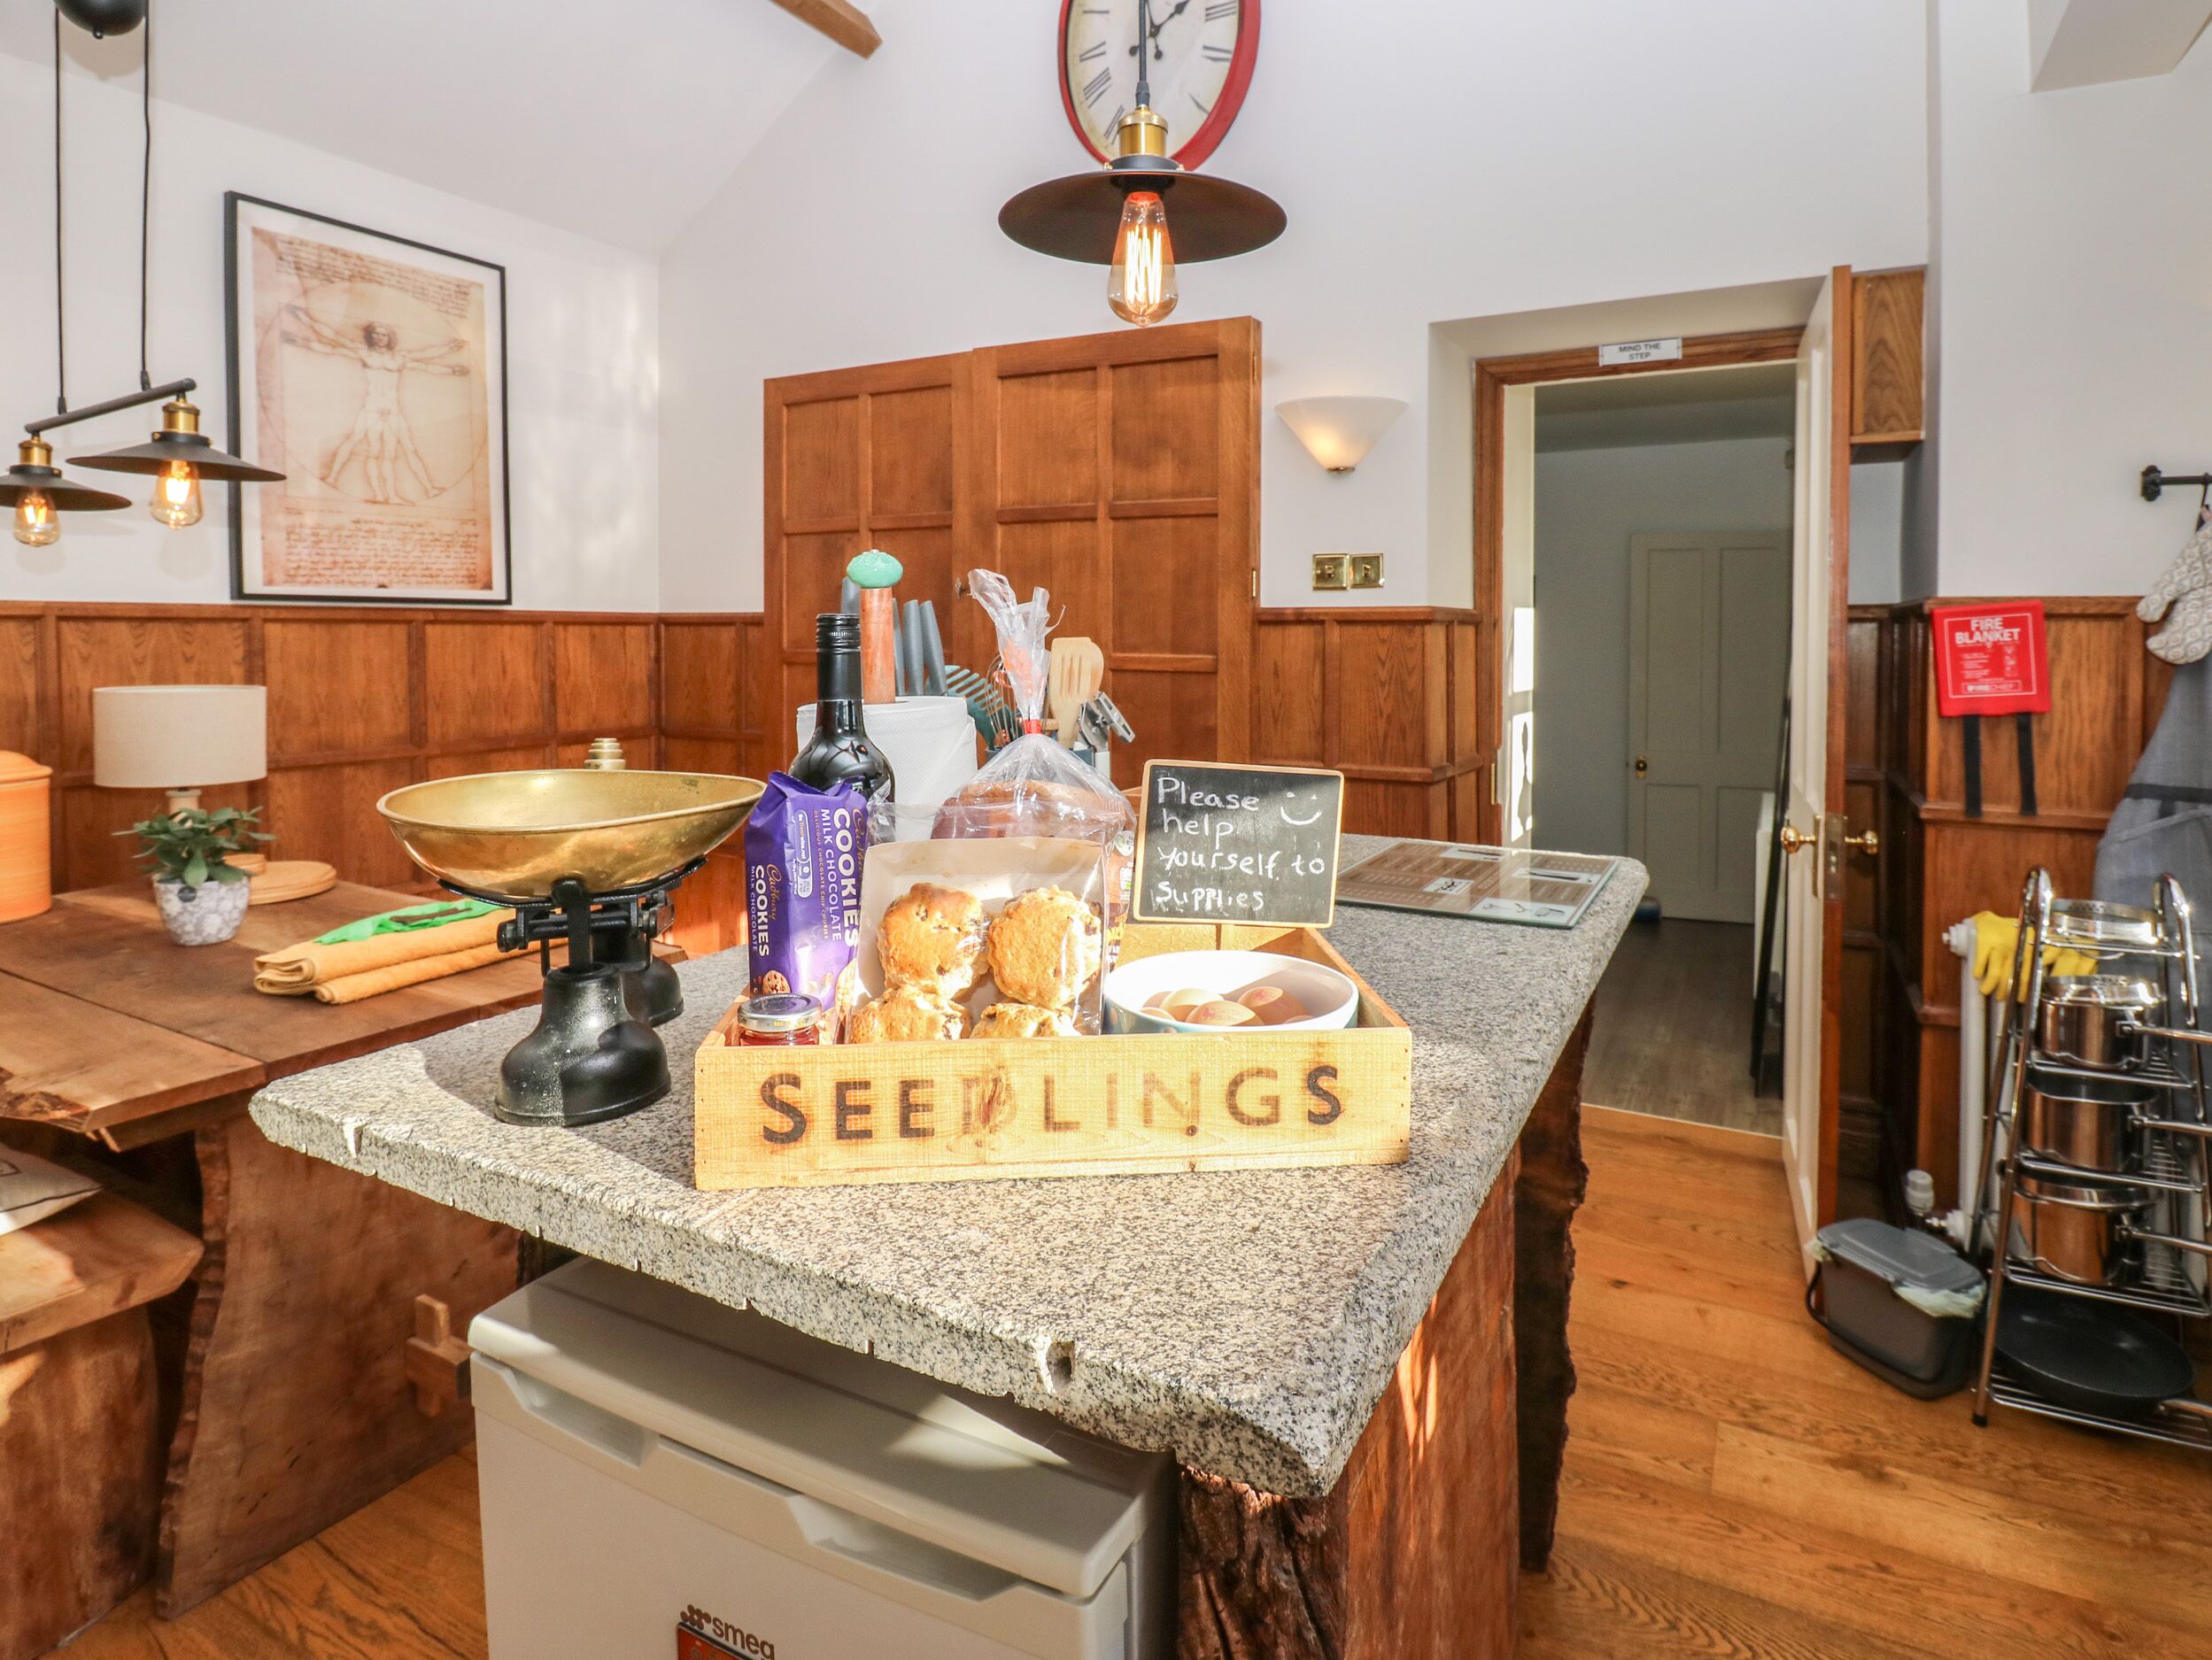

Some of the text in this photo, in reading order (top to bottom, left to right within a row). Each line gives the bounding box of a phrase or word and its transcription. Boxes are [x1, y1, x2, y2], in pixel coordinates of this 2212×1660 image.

[1955, 629, 2021, 644] BLANKET
[1970, 618, 2003, 630] FIRE
[1156, 776, 1259, 811] Please
[1163, 807, 1234, 850] help
[821, 808, 842, 942] MILK CHOCOLATE
[833, 807, 860, 948] COOKIES
[1157, 846, 1282, 879] yourself
[1290, 854, 1326, 876] to
[755, 864, 770, 957] COOKIES
[767, 863, 782, 921] Cadbury
[820, 908, 829, 940] COOKIES
[760, 1064, 1343, 1145] SEEDLINGS
[712, 1616, 775, 1660] smeg
